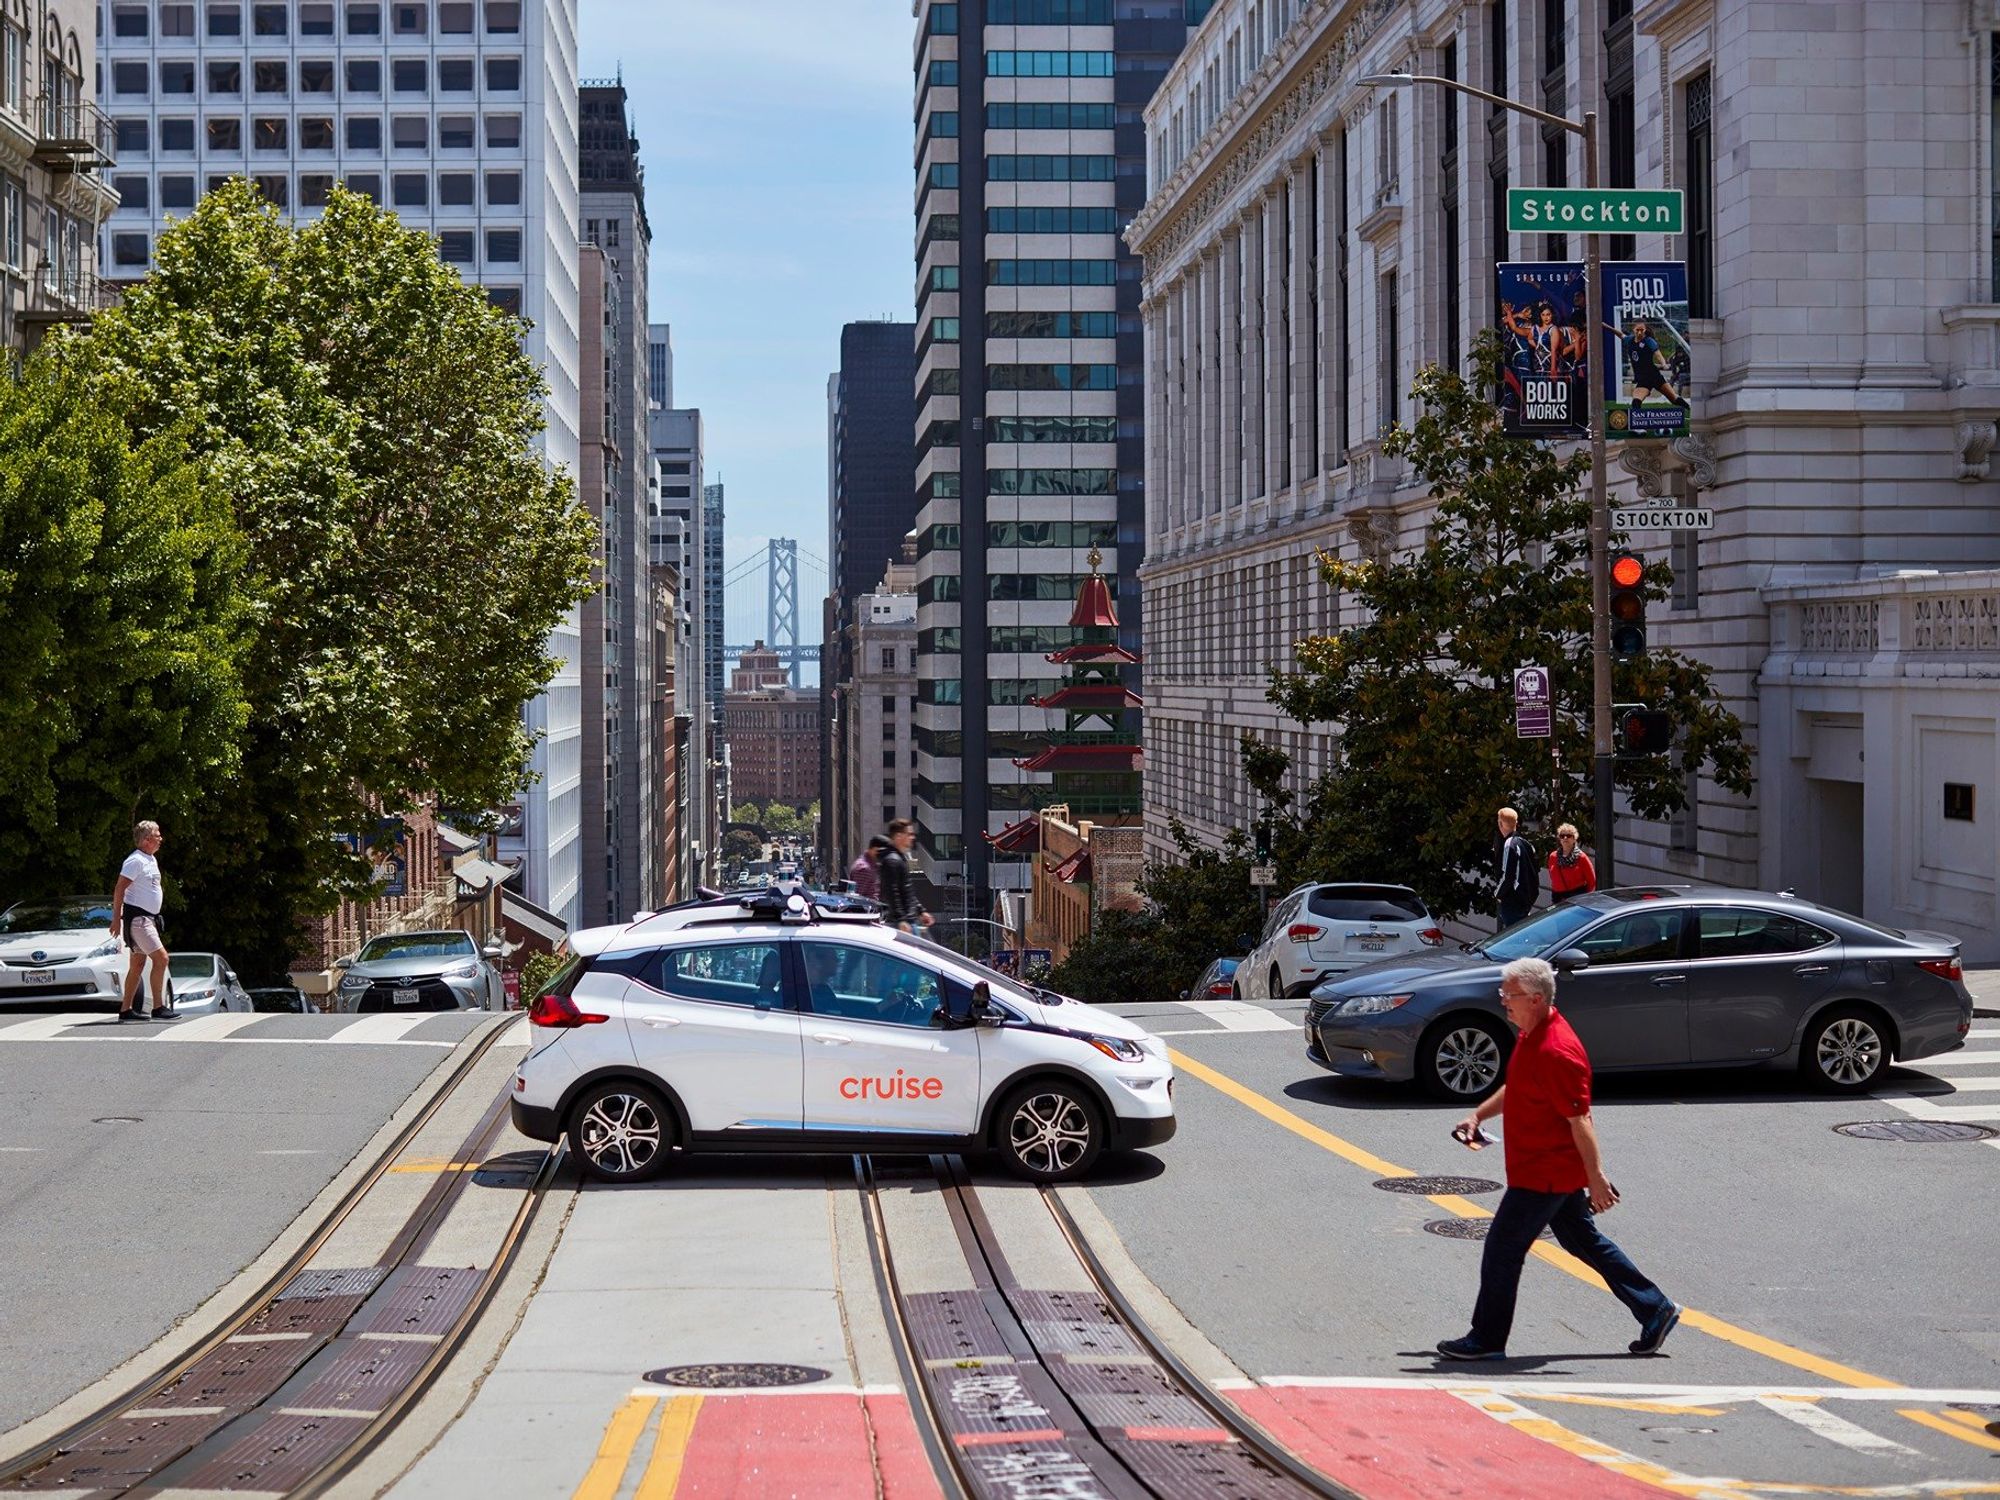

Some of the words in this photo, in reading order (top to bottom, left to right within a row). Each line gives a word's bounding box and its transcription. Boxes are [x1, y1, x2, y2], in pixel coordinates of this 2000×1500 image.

[1522, 199, 1670, 223] Stockton
[1621, 278, 1664, 299] BOLD
[1622, 300, 1666, 318] PLAYS
[1526, 381, 1567, 403] BOLD
[1526, 404, 1567, 419] WORKS
[1616, 512, 1708, 526] STOCKTON
[840, 1069, 943, 1099] cruise
